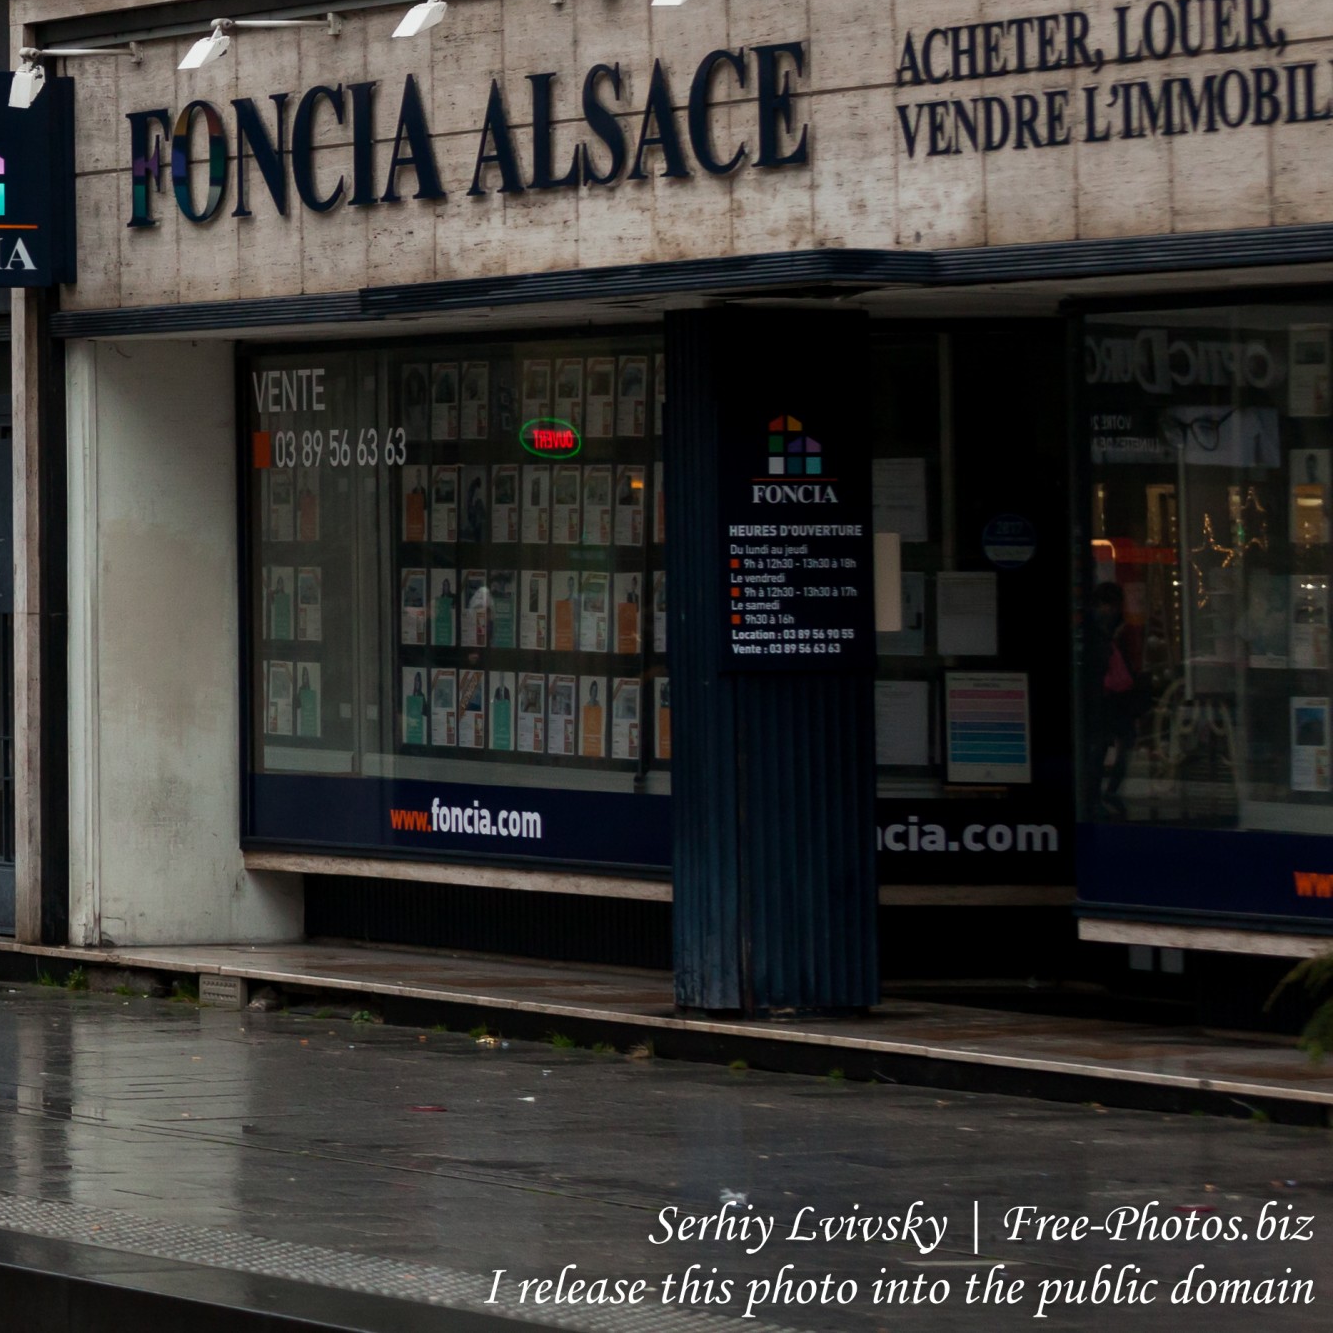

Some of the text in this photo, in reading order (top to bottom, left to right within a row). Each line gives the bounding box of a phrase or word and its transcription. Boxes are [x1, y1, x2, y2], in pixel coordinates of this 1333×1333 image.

[895, 11, 1103, 86] ACHETER,
[896, 59, 1333, 158] VENDRE L'IMMOBIL
[126, 41, 809, 228] FONCIA ALSACE
[252, 368, 326, 413] VENTE
[275, 427, 406, 467] 03 89 56 63 63
[751, 485, 839, 503] FONCIA
[729, 524, 863, 537] HEURES D'OUVERTURE
[729, 543, 809, 557] Du lundi au jeudi
[743, 558, 755, 569] 9h
[757, 557, 765, 569] à
[766, 558, 794, 569] 12h30
[802, 558, 831, 569] 13h30
[831, 557, 838, 569] à
[839, 558, 857, 569] 18h
[731, 573, 787, 583] Le vendredi
[743, 587, 756, 598] 9h
[758, 587, 765, 597] à
[767, 587, 795, 597] 12h30
[803, 587, 831, 597] 13h30
[833, 587, 839, 597] à
[841, 587, 858, 597] 17h
[731, 599, 781, 611] Le samedi
[745, 613, 795, 625] 9h30 à 16h
[732, 629, 777, 640] Location
[783, 629, 796, 640] 03
[797, 629, 811, 640] 89
[812, 629, 825, 640] 56
[827, 629, 839, 640] 90
[841, 629, 855, 640] 55
[732, 643, 762, 655] Vente
[769, 643, 783, 655] 03
[784, 643, 797, 655] 89
[799, 643, 811, 655] 56
[813, 643, 826, 655] 63
[827, 643, 841, 655] 63
[390, 797, 542, 839] www.foncia.com
